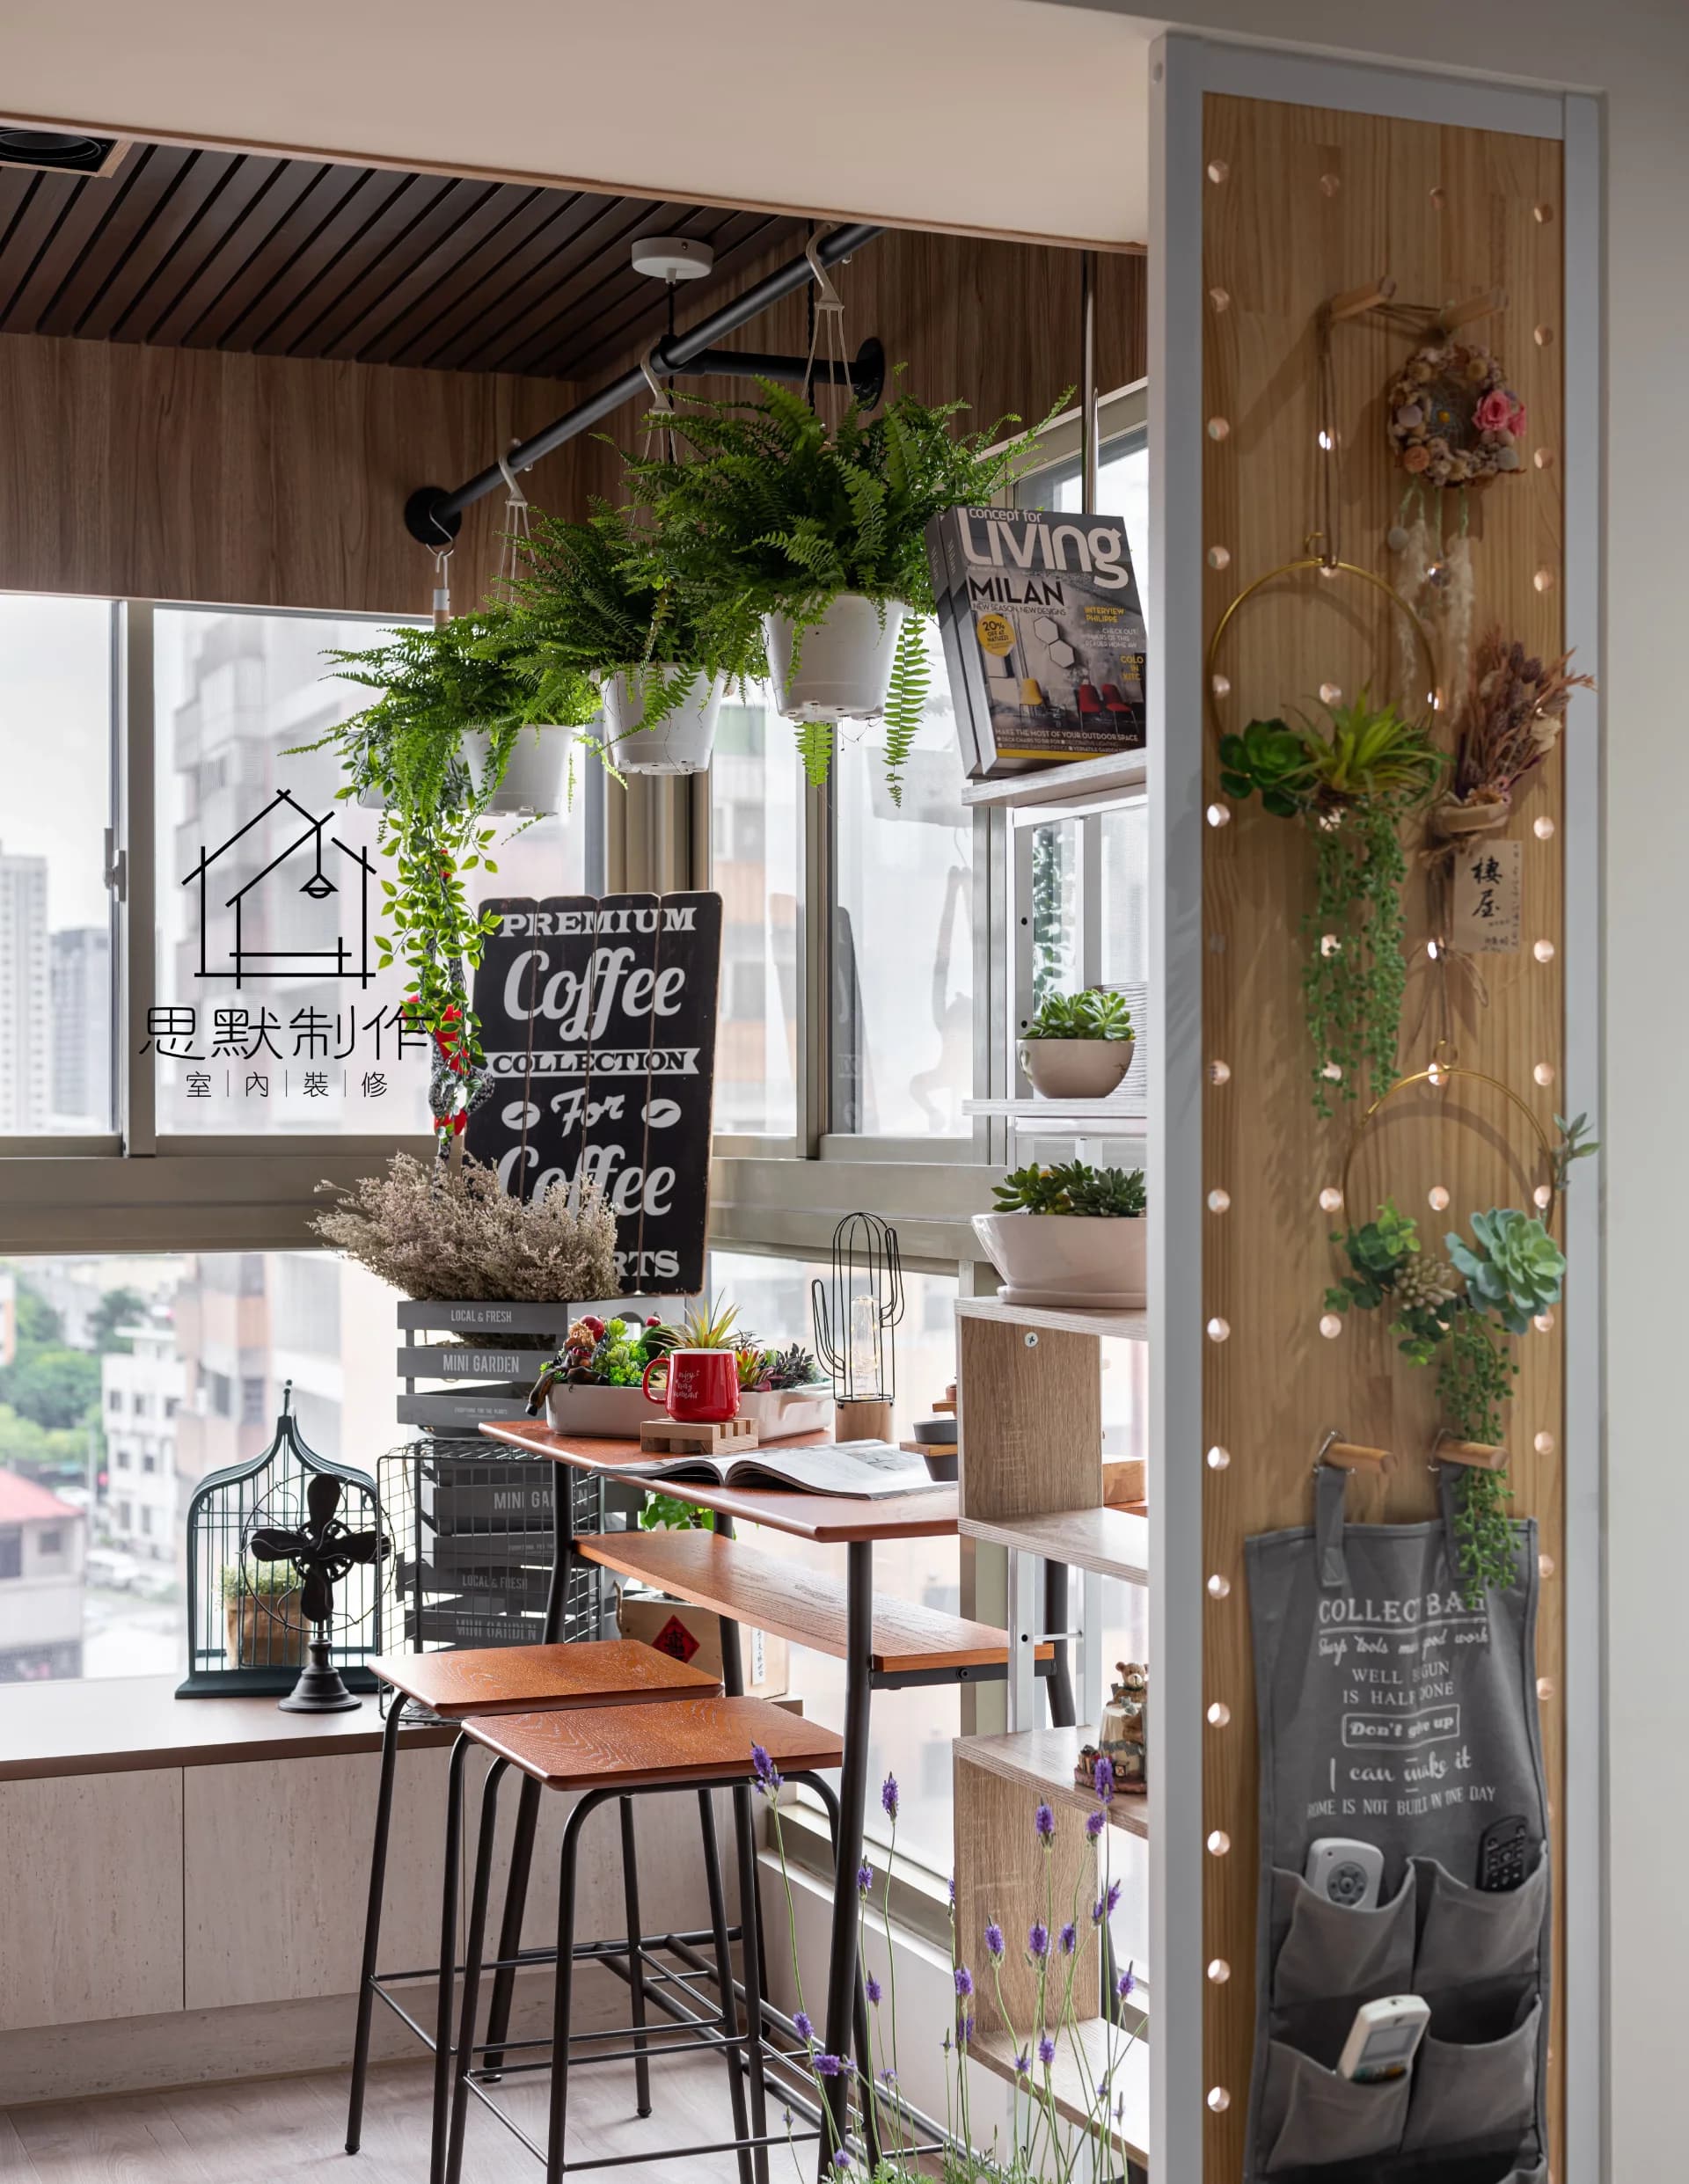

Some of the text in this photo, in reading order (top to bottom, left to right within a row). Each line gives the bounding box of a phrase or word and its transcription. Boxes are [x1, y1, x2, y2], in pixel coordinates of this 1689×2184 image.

[969, 508, 1042, 522] concept for
[969, 576, 1064, 610] MILAN
[983, 621, 1005, 631] 20%
[499, 908, 697, 938] PREMIUM
[504, 947, 685, 1041] Coffee
[493, 1051, 686, 1073] COLLECTION
[551, 1086, 625, 1137] For
[450, 1309, 512, 1323] LOCAL & FRESH
[442, 1355, 519, 1373] MINI GARDEN
[494, 1492, 524, 1509] MINI
[462, 1574, 489, 1588] LOCAL
[501, 1575, 528, 1589] FRESH
[456, 1619, 537, 1640] MINI GARDEN
[1352, 1668, 1403, 1684] WELL
[1343, 1690, 1359, 1704] IS
[1371, 1690, 1416, 1706] HALF
[1350, 1721, 1403, 1737] Don't
[1433, 1716, 1454, 1730] up
[1330, 1757, 1336, 1793] I
[1349, 1767, 1395, 1782] can
[1455, 1745, 1472, 1770] it
[1342, 1799, 1356, 1815] IS
[1364, 1799, 1389, 1816] NOT
[1470, 1786, 1495, 1802] DAY
